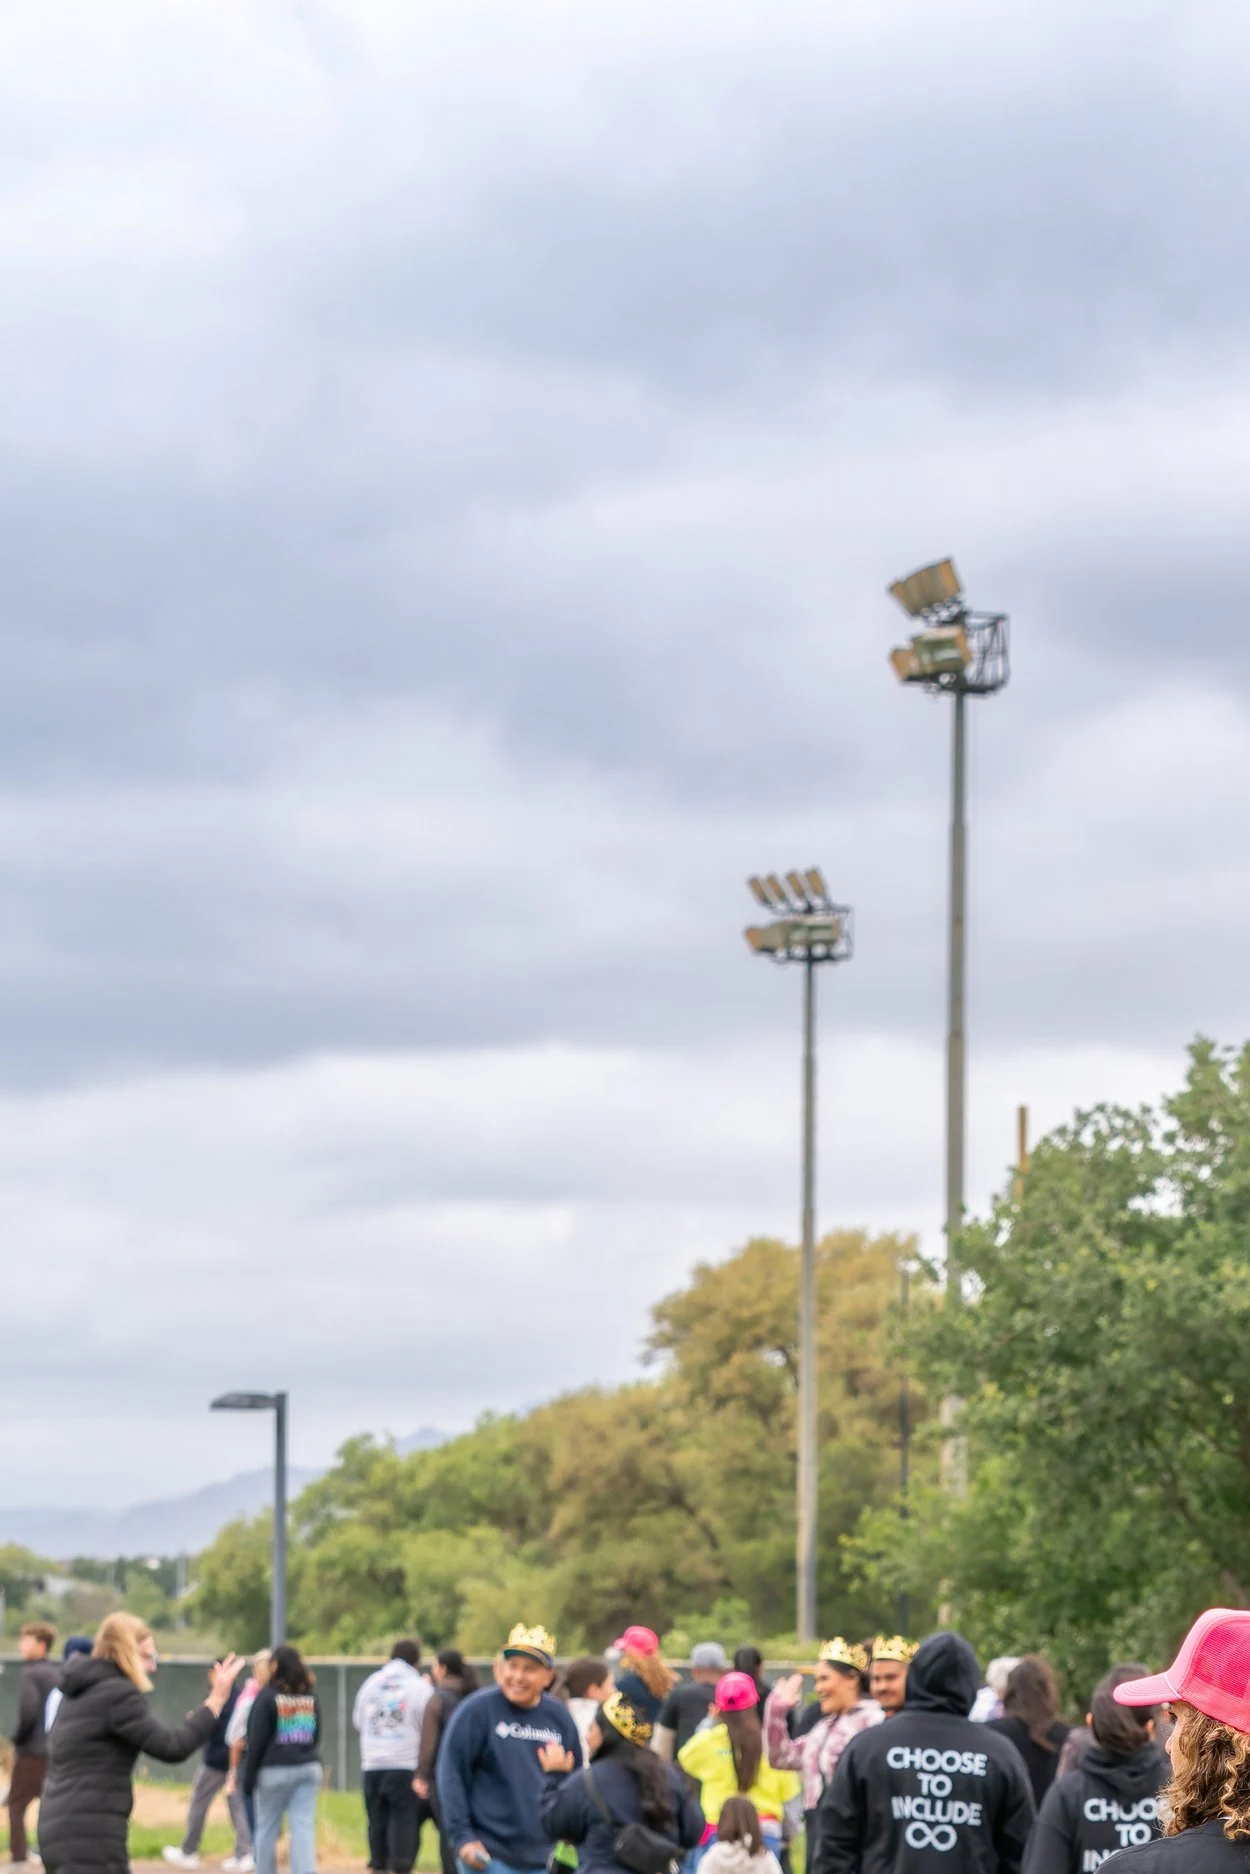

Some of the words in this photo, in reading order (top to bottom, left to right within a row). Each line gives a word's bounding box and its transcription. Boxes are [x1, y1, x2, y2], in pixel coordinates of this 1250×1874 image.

[886, 1747, 987, 1777] CHOOSE
[917, 1772, 952, 1797] TO
[891, 1796, 982, 1826] INCLUDE
[1114, 1823, 1152, 1847] TO
